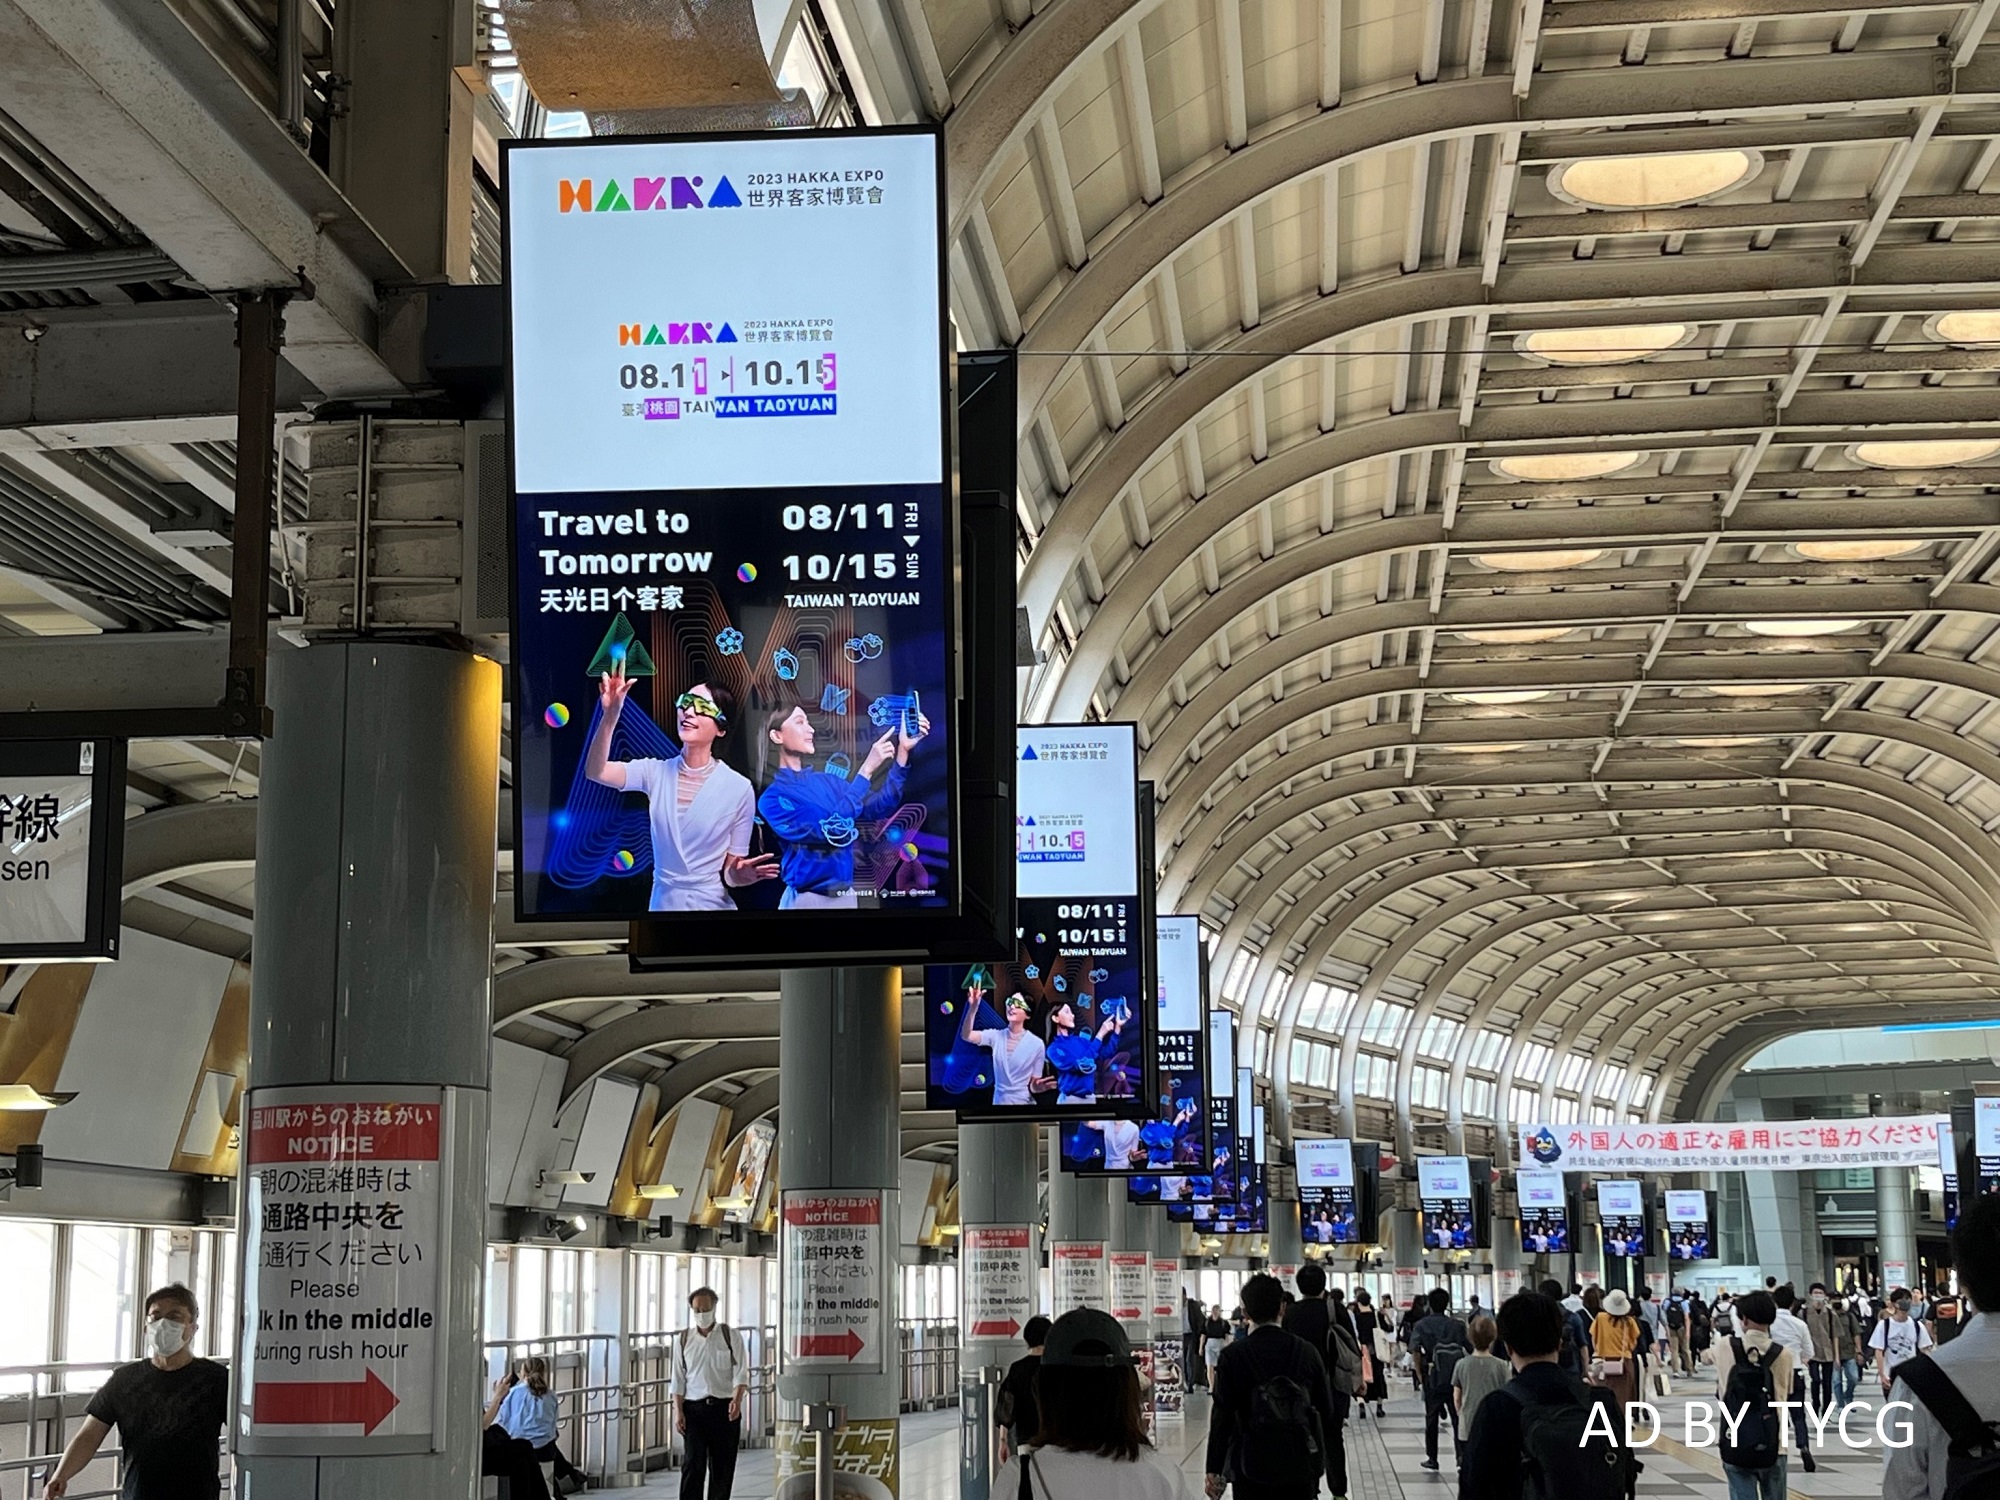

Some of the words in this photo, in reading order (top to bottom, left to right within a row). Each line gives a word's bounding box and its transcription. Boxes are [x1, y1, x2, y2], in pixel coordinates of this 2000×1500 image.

[747, 174, 783, 185] 2023
[787, 172, 840, 184] HAKKA
[844, 170, 885, 182] EXPO
[559, 175, 742, 213] HAKKA
[747, 186, 884, 207] 世界客家博覽會
[619, 322, 738, 346] HAKKA
[744, 320, 767, 329] 2023
[770, 319, 804, 329] HAKKA
[807, 318, 833, 327] EXPO
[744, 329, 833, 344] 世界客家博覽會
[745, 358, 834, 387] 10.15
[683, 400, 750, 414] TAIWAN
[754, 397, 834, 412] TAOYUAN
[538, 508, 647, 536] Travel
[656, 508, 690, 534] to
[782, 502, 895, 531] 08/11
[904, 502, 918, 528] FRI
[538, 549, 713, 576] Tomorrow
[782, 552, 897, 582] 10/15
[905, 553, 918, 579] SUN
[539, 585, 685, 613] 天光日个客家
[784, 593, 844, 608] TAIWAN
[849, 591, 920, 608] TAOYUAN
[1039, 834, 1084, 848] 10.15
[1057, 904, 1114, 919] 08/11
[1057, 928, 1115, 944] 10/15
[251, 1104, 433, 1131] 品川駅からのおねがい
[288, 1135, 374, 1155] NOTICE
[261, 1166, 412, 1196] 朝の混雑時は
[262, 1201, 404, 1233] 通路中央を
[805, 1211, 849, 1222] NOTICE
[801, 1227, 868, 1242] の混雑時は
[290, 1279, 360, 1299] Please
[808, 1284, 845, 1294] Please
[817, 1298, 837, 1310] the
[840, 1297, 880, 1310] middle
[279, 1309, 298, 1331] in
[305, 1308, 343, 1331] the
[351, 1307, 433, 1330] middle
[819, 1314, 843, 1325] rush
[845, 1313, 869, 1324] hour
[254, 1340, 301, 1366] during
[308, 1340, 353, 1360] rush
[361, 1339, 409, 1360] hour
